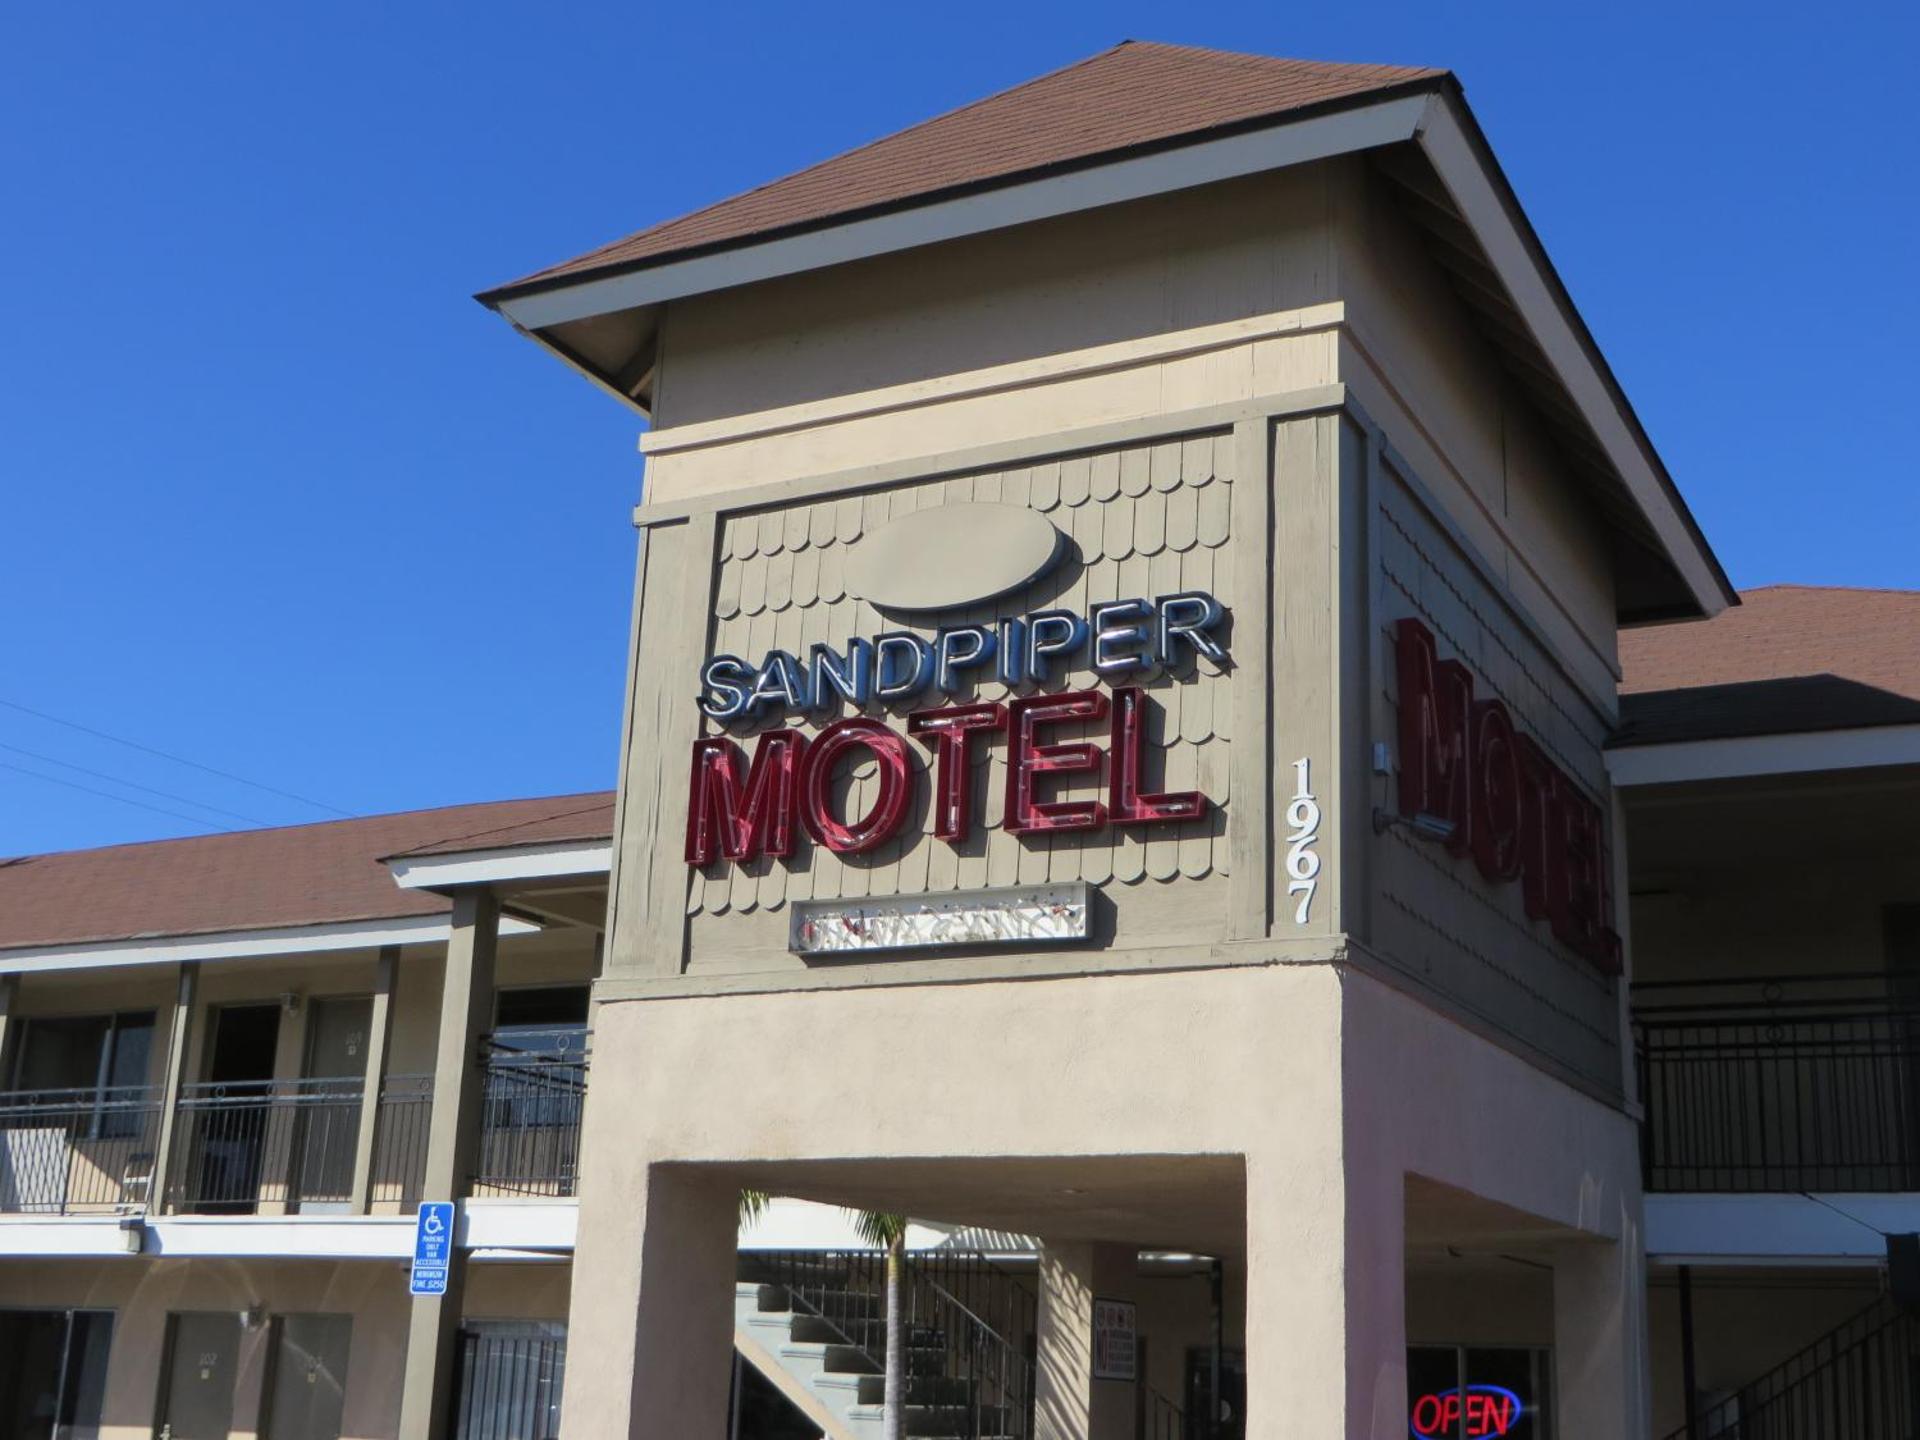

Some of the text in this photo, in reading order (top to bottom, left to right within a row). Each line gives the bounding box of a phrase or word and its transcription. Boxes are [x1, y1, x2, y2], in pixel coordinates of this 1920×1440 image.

[697, 591, 1230, 722] SANDPIPER
[685, 687, 1207, 864] MOTEL
[1287, 757, 1321, 924] 1967
[1412, 1394, 1509, 1435] OPEN
